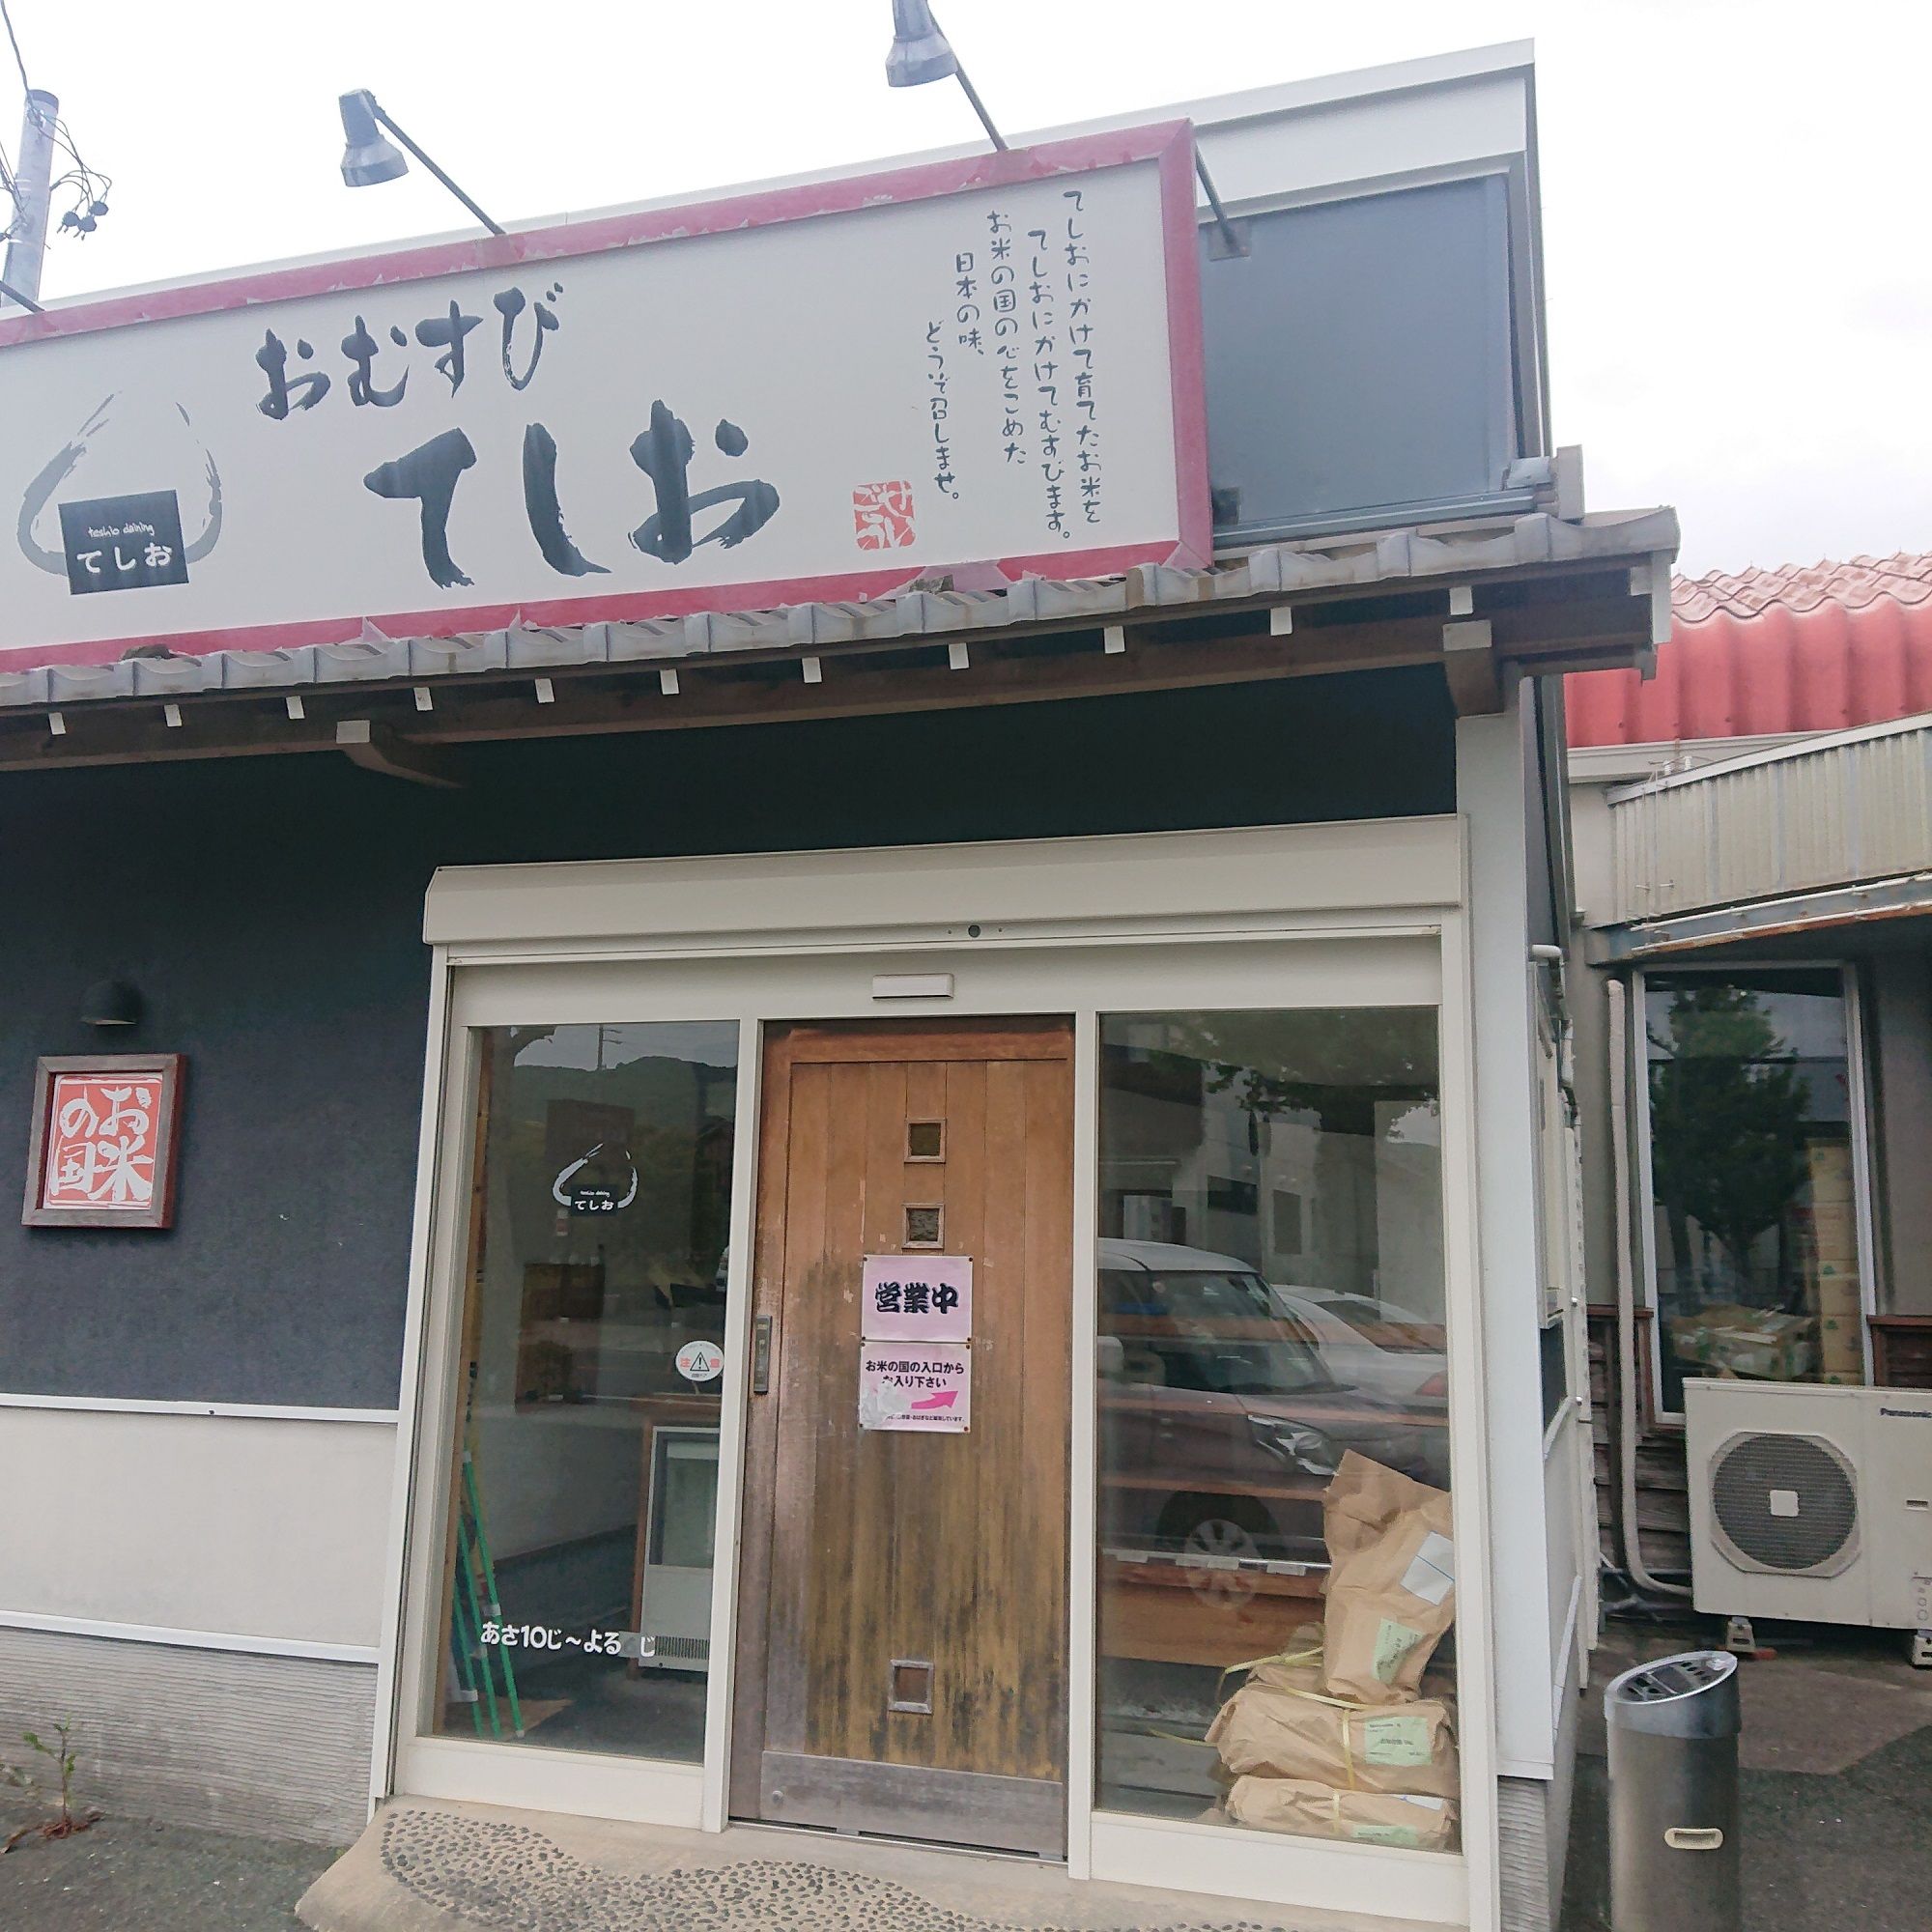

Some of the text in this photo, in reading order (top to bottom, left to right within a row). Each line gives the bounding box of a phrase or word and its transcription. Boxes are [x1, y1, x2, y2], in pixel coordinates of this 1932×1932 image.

[255, 281, 565, 420] おむすび
[925, 319, 959, 500] どうぞ召しませ。
[987, 209, 1027, 465] お米の国の心をこめた
[1027, 229, 1070, 539] てしおにかけてむすびます。
[1063, 189, 1102, 525] てしおにかけて育てたお米を
[76, 542, 173, 574] てしお
[363, 398, 781, 591] てしお
[574, 1199, 614, 1211] てしお
[865, 1359, 965, 1376] お米の国の入口から
[874, 1281, 959, 1316] 営業中
